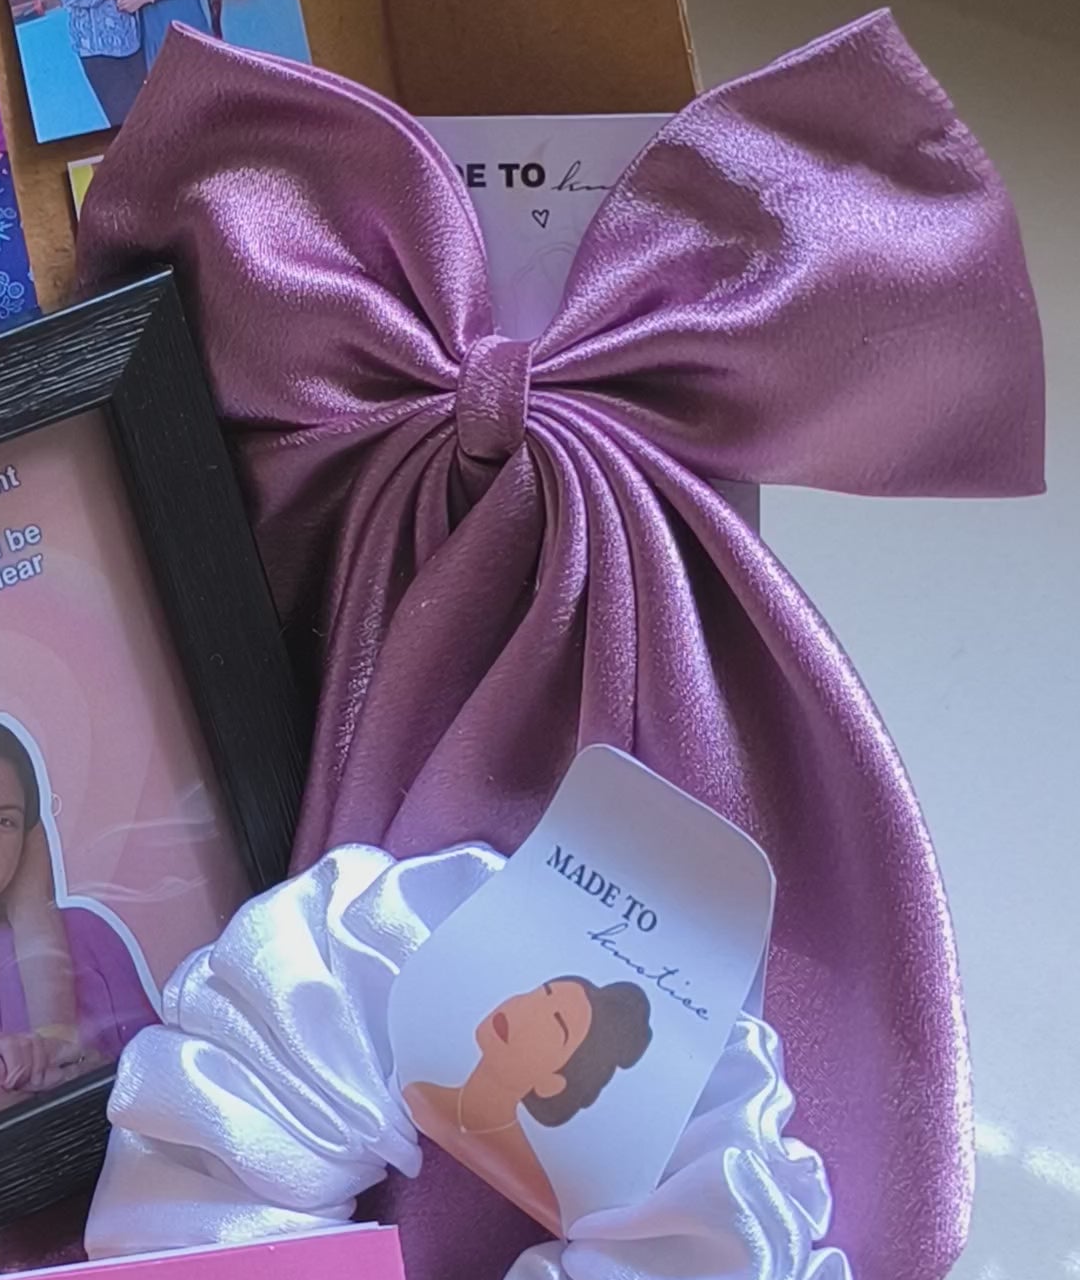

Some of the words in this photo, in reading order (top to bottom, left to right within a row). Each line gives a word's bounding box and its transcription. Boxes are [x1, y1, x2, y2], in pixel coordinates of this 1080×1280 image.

[497, 162, 546, 188] TO
[5, 524, 42, 552] be
[546, 846, 621, 908] MADE
[622, 895, 657, 932] TO
